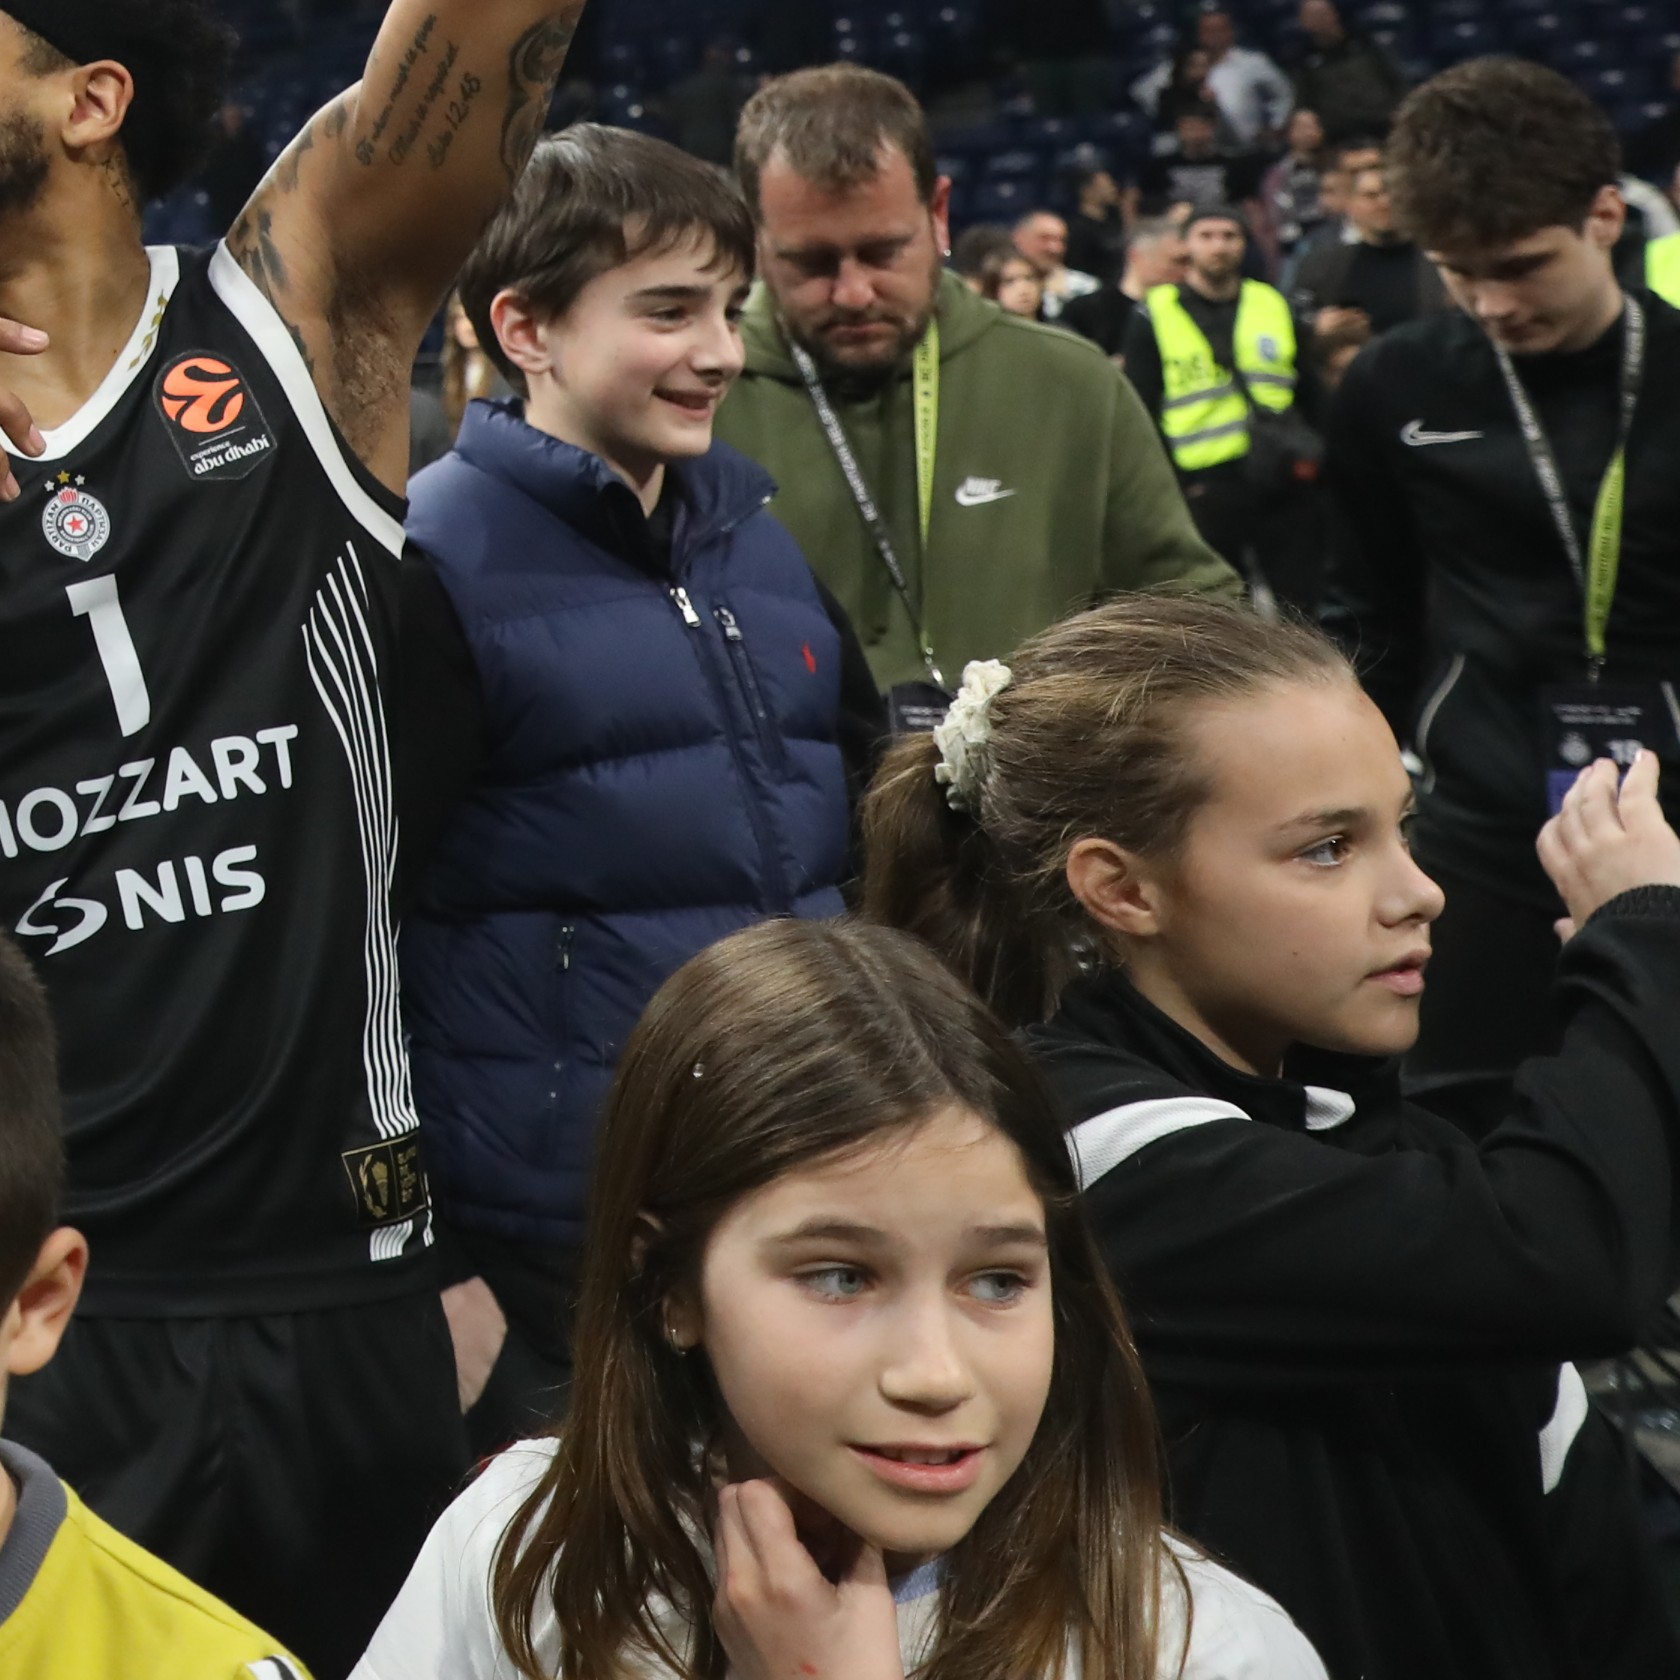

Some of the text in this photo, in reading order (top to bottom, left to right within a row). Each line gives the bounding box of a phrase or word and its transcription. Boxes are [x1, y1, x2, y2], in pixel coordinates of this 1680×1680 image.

[194, 434, 270, 475] abu dhabi
[65, 572, 150, 738] 1
[115, 844, 265, 931] NIS
